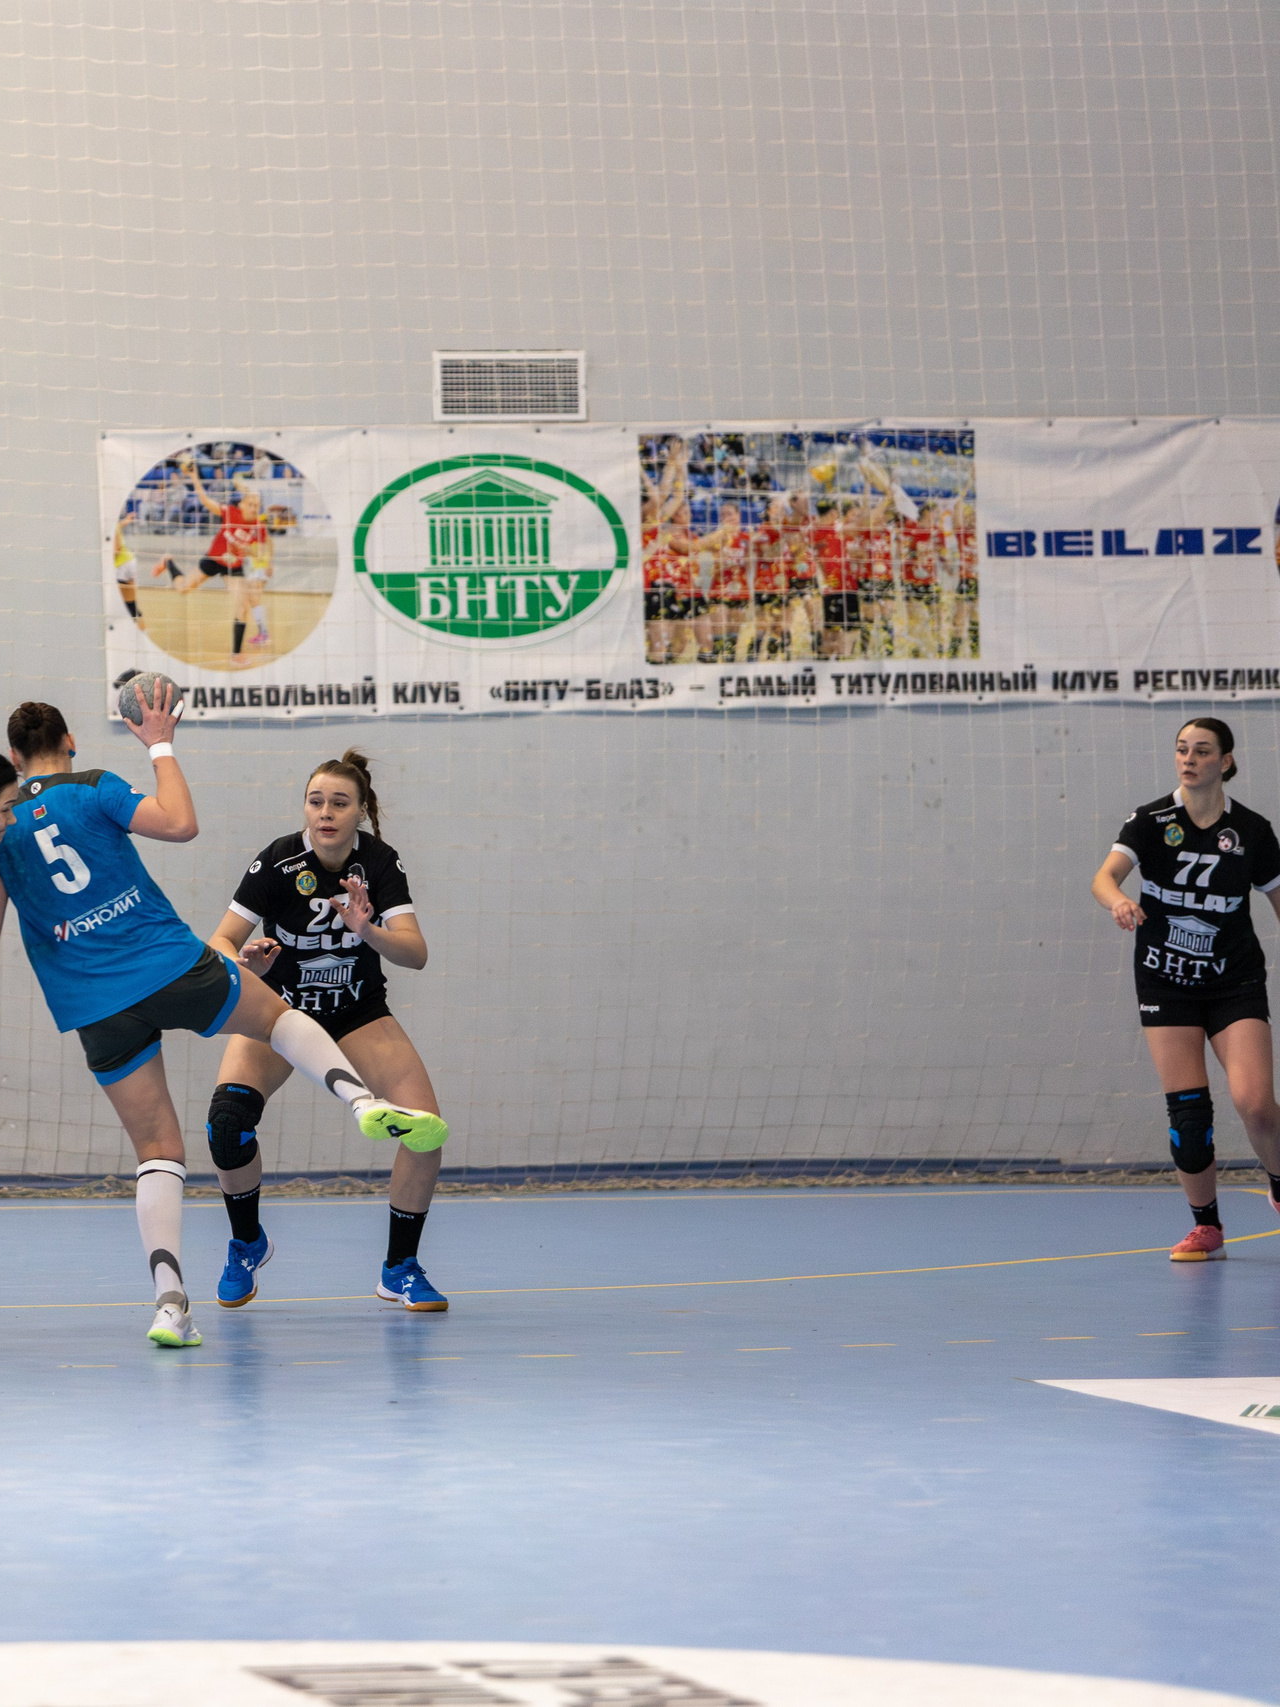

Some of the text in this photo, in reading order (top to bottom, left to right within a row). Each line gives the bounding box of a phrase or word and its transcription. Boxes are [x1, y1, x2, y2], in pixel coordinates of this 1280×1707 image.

[986, 527, 1263, 558] BELAZ
[419, 574, 580, 620] БНТУ
[392, 681, 461, 704] КЛУБ
[719, 667, 817, 698] САМЫЙ
[831, 663, 1038, 695] ТИТУЛОВАННЫЙ
[1052, 669, 1119, 692] КЛУБ
[33, 823, 91, 895] 5
[1173, 851, 1221, 887] 77
[1141, 879, 1244, 913] BELAZ
[275, 923, 366, 950] BELA
